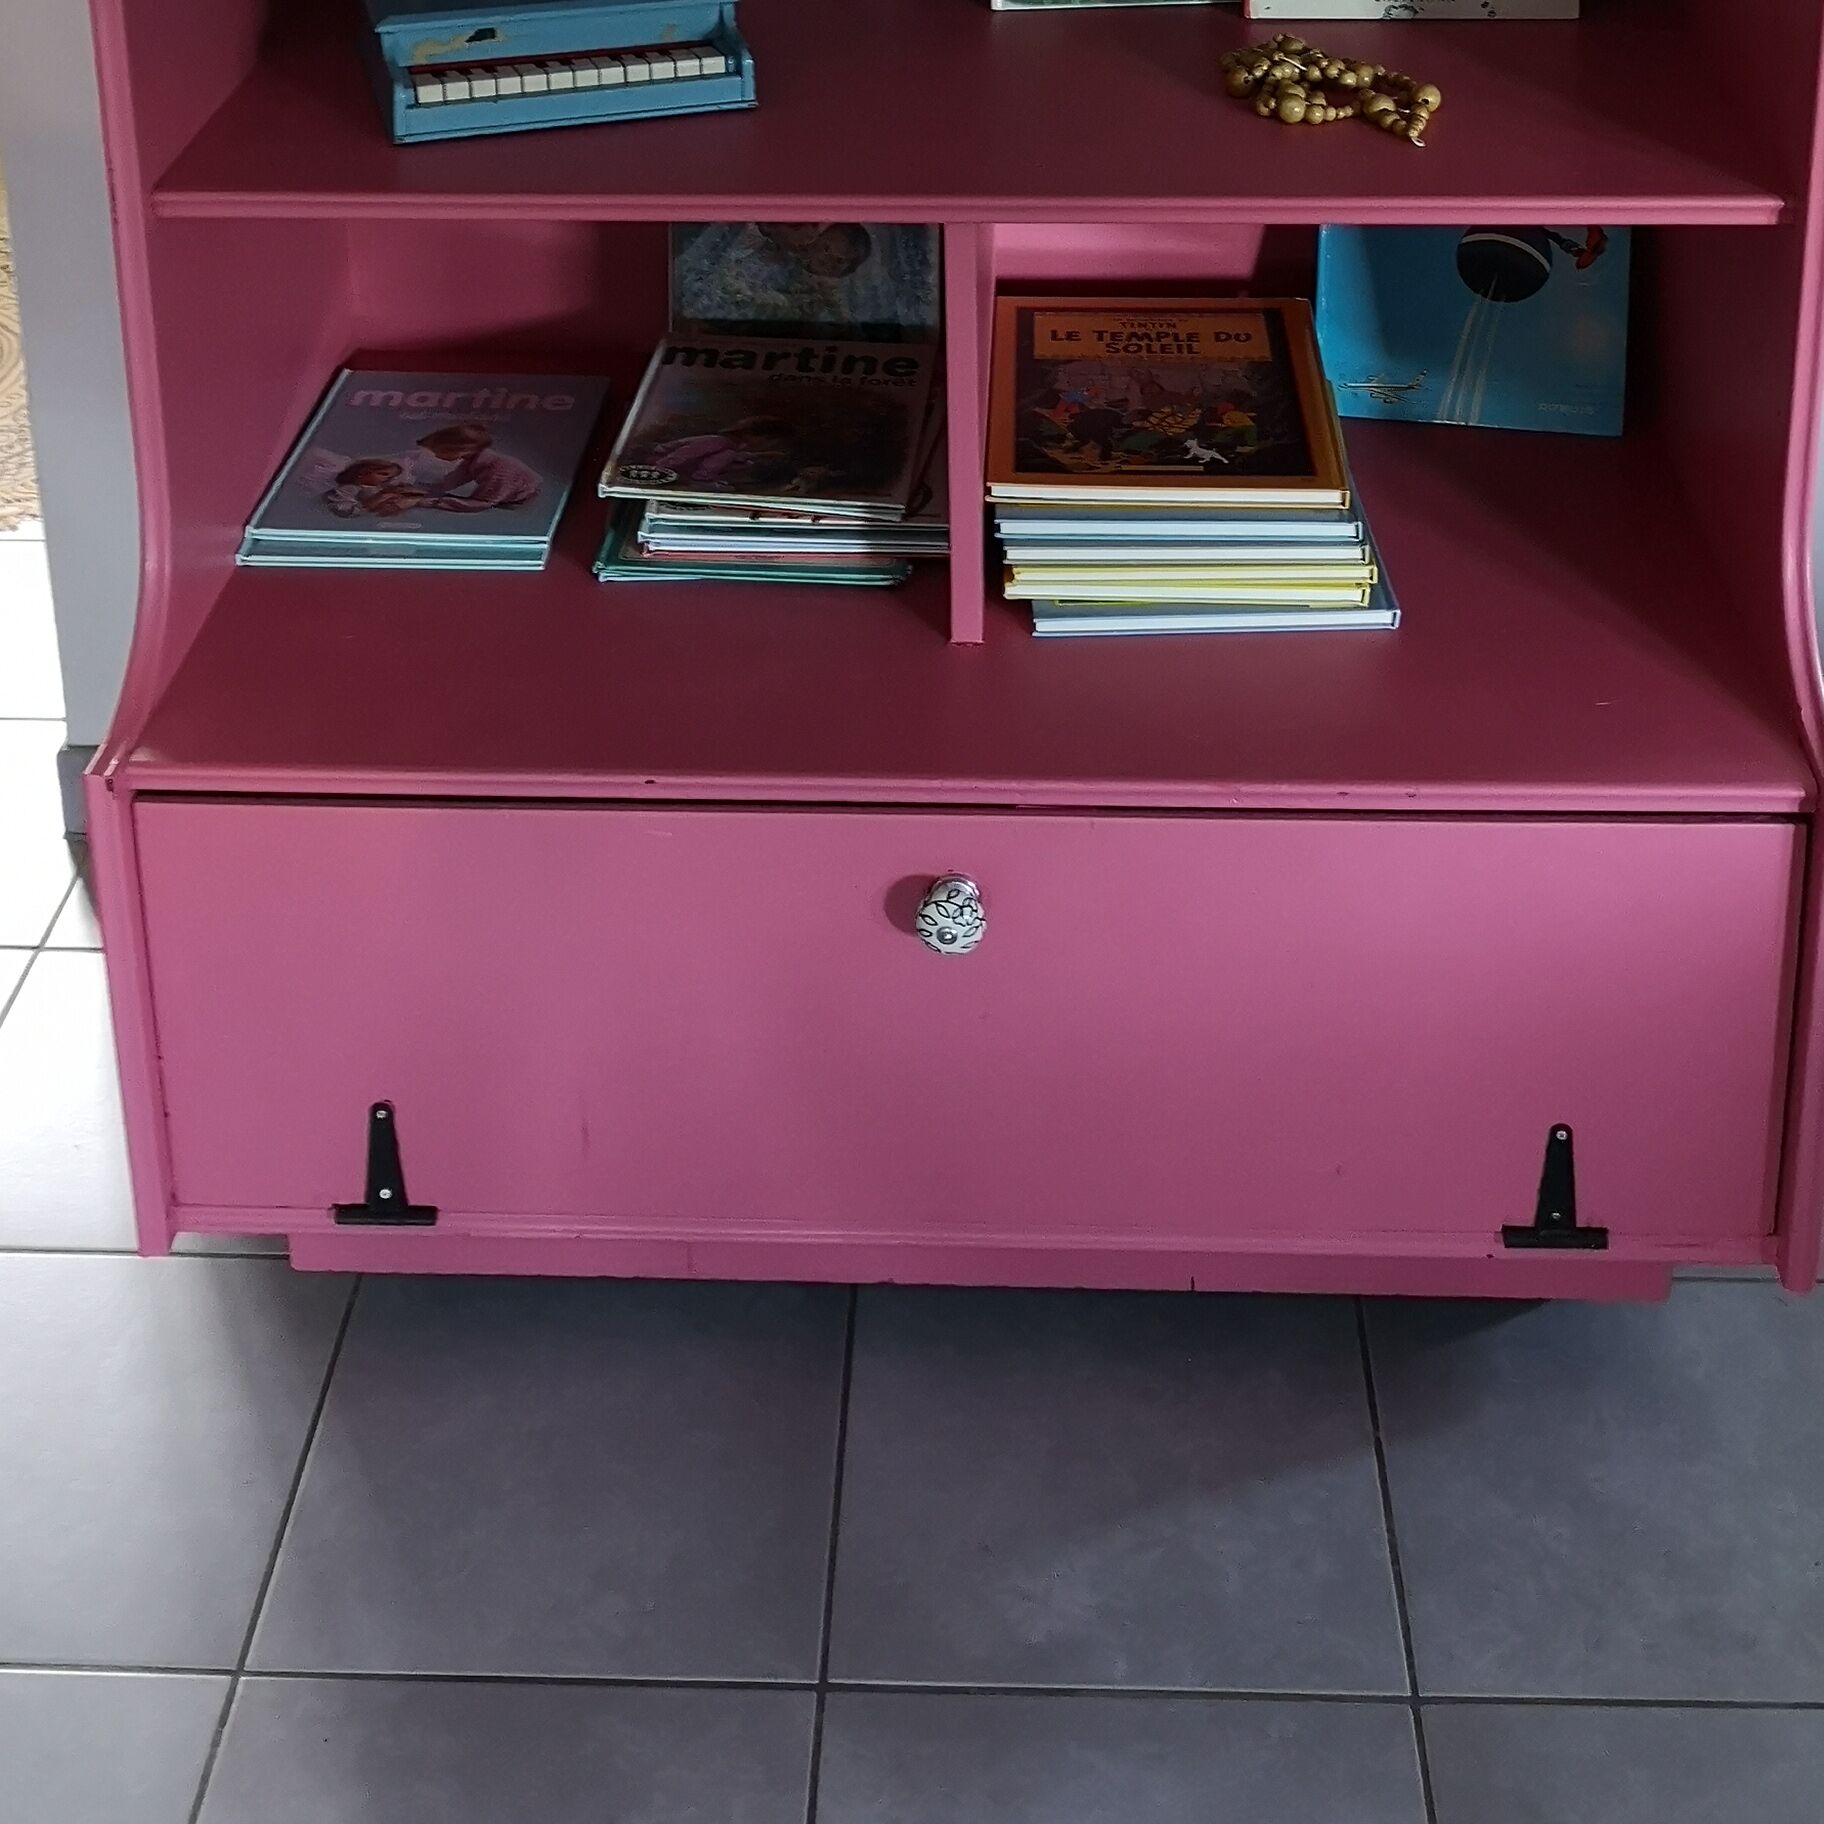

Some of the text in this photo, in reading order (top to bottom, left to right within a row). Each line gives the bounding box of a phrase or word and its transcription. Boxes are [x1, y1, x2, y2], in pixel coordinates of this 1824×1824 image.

[1050, 329, 1252, 343] LE TEMPLE DU
[1105, 342, 1201, 355] SOLEIL
[661, 345, 920, 377] martine
[349, 387, 576, 411] martine
